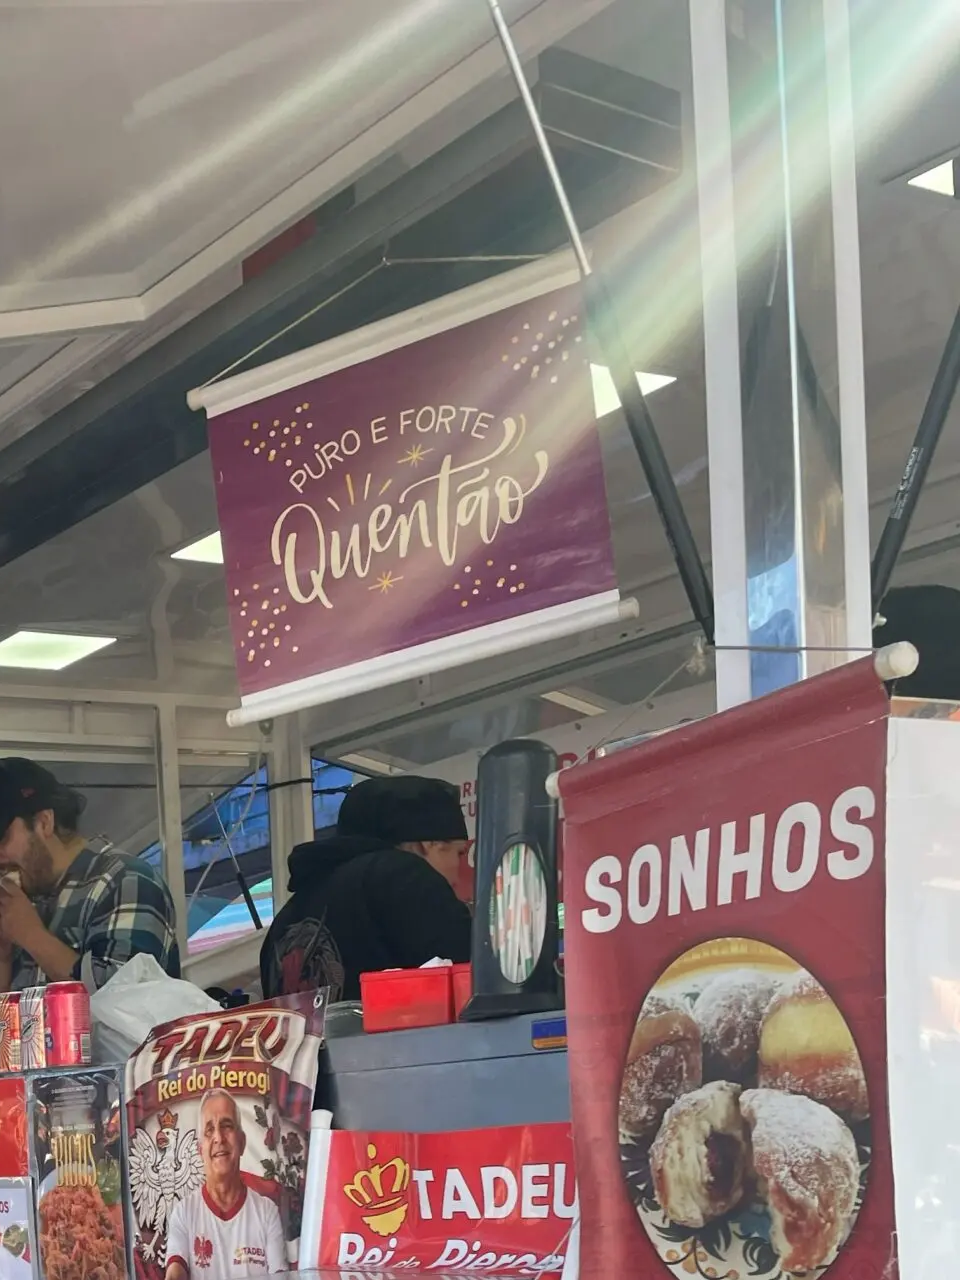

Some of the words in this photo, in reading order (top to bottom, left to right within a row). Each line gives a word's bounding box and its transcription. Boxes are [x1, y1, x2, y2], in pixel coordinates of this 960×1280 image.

[289, 429, 361, 494] PURO
[371, 416, 388, 443] E
[399, 405, 496, 439] FORTE
[271, 417, 549, 609] Quentão
[581, 785, 876, 934] SONHOS
[151, 1014, 291, 1077] TADEU
[158, 1071, 182, 1102] Rei
[186, 1068, 206, 1092] do
[210, 1064, 271, 1096] Pierogi
[412, 1163, 579, 1220] TADEU
[337, 1232, 397, 1266] Rei
